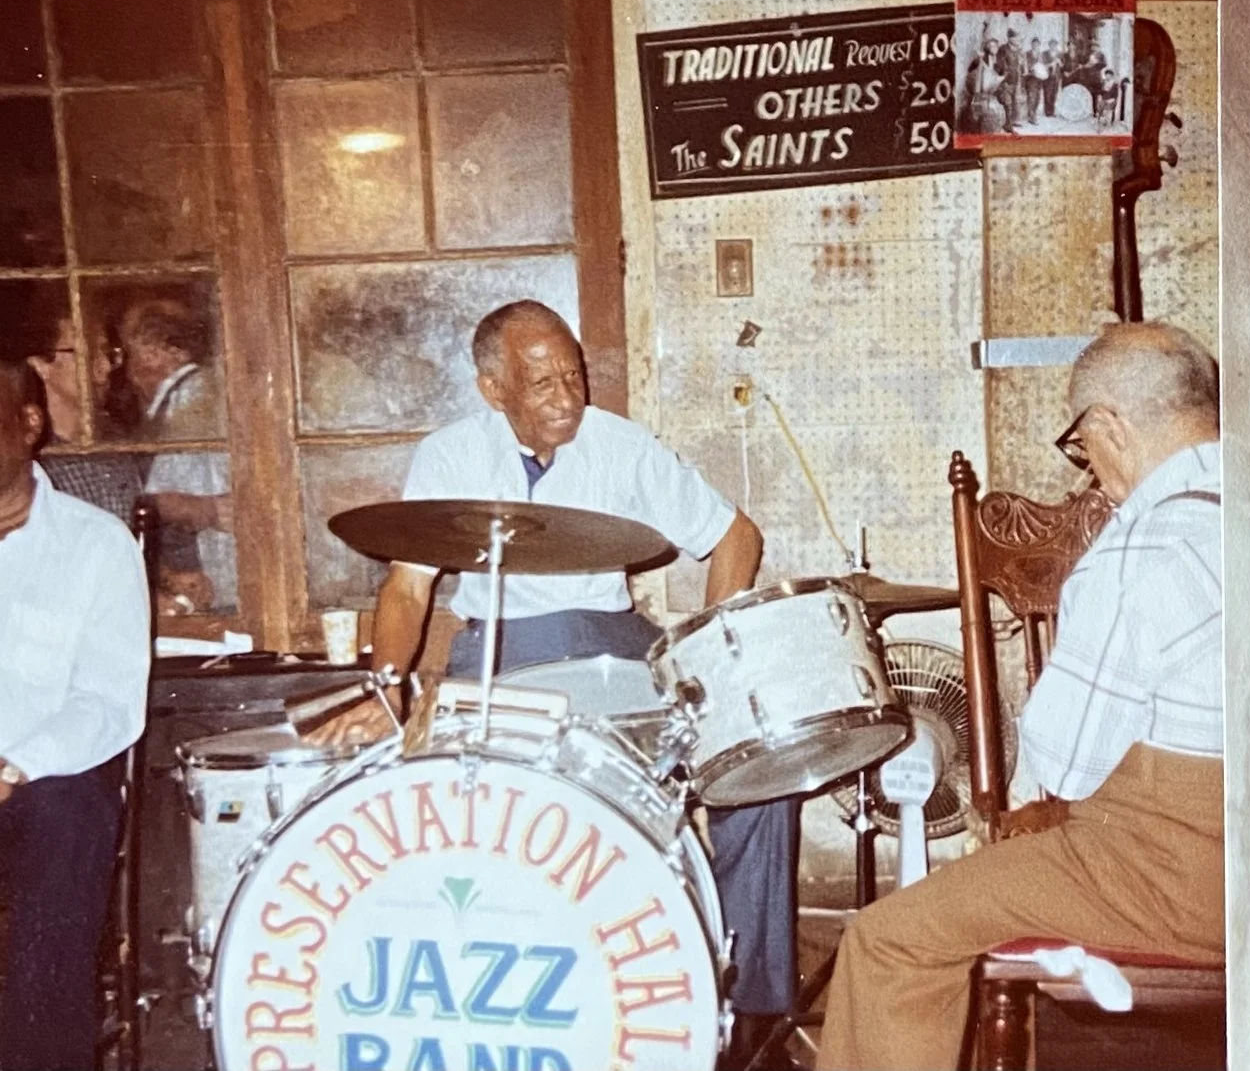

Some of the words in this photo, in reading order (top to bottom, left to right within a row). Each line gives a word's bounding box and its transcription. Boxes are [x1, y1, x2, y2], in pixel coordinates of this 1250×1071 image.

[662, 36, 835, 86] TRADITIONAL
[756, 79, 883, 121] OTHERS
[670, 140, 708, 173] The
[243, 779, 628, 1071] PRESERVATION
[591, 895, 694, 1071] HAL
[335, 936, 581, 1030] JAZZ
